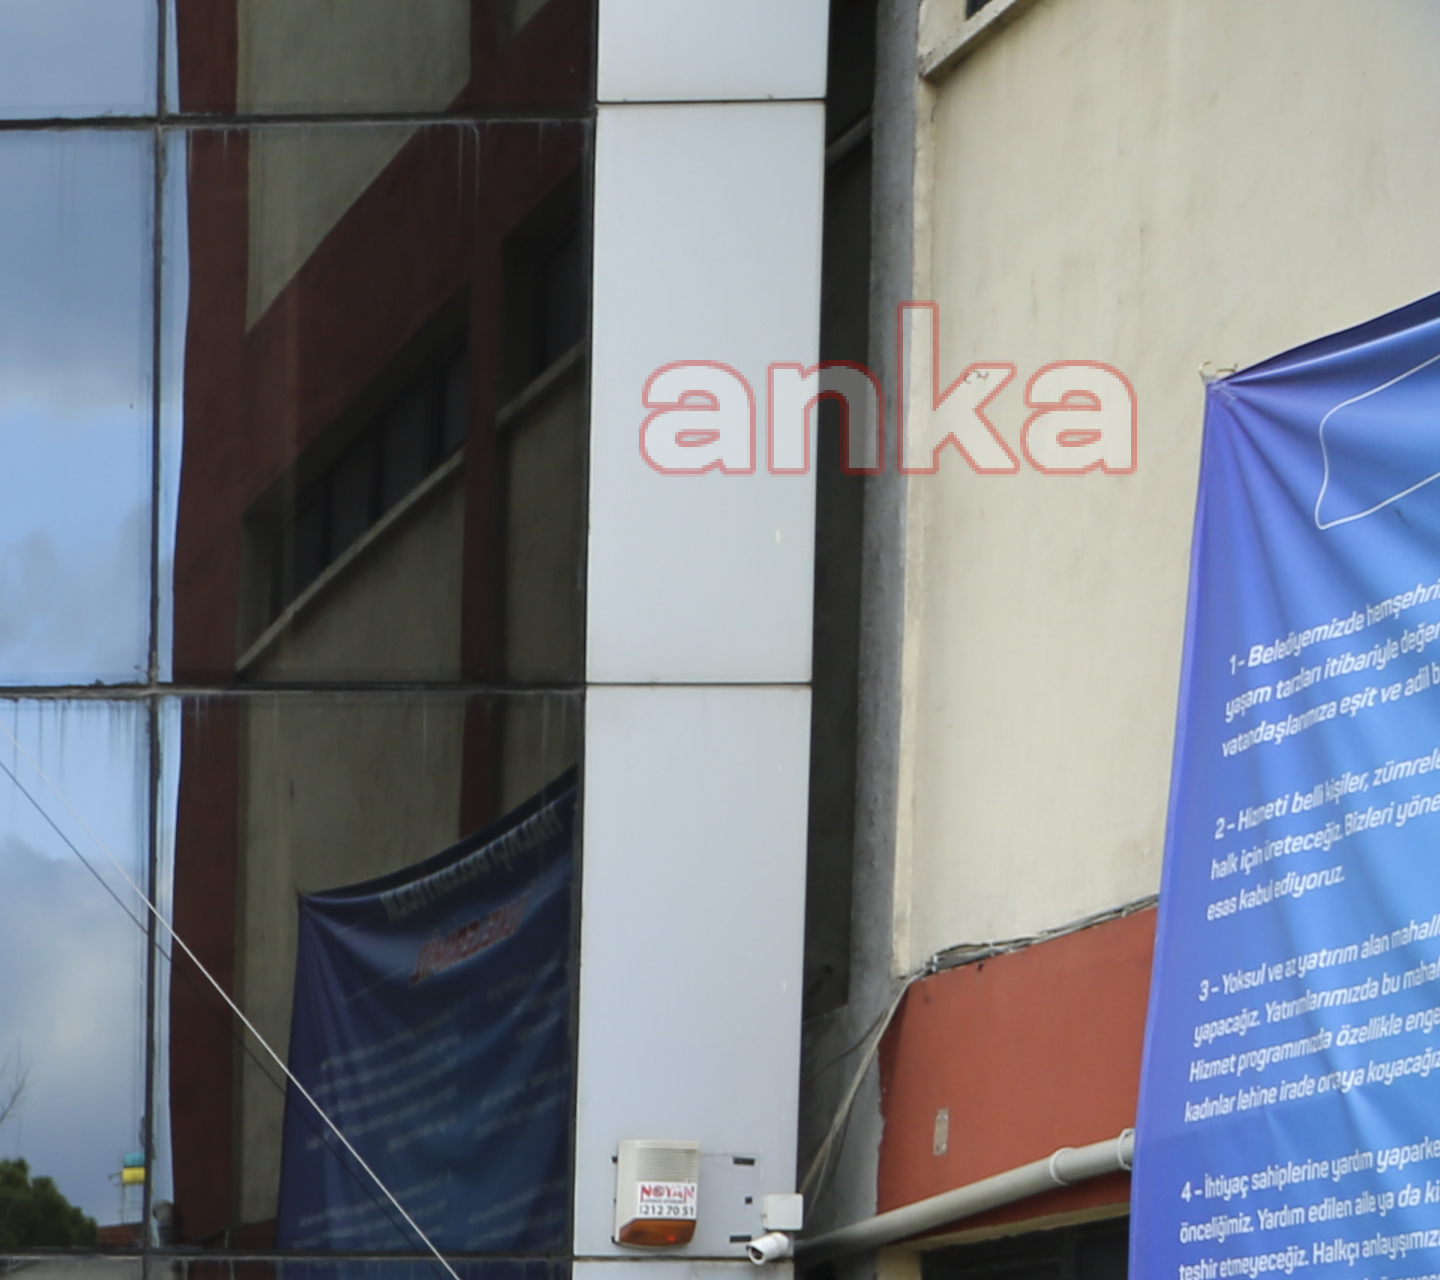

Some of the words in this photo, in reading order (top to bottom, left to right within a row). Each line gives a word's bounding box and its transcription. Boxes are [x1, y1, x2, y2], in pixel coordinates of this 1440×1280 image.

[1247, 611, 1365, 668] Belediyemizde
[1222, 700, 1337, 758] vatandaşlarımıza
[1339, 687, 1379, 718] eşit
[1381, 682, 1402, 704] ve
[1404, 666, 1430, 697] adil
[1225, 686, 1272, 723] yaşam
[1276, 666, 1322, 699] tarzları
[1323, 638, 1400, 681] itibariyle
[1214, 816, 1226, 840] 2
[1238, 793, 1289, 833] Hizmeti
[1291, 785, 1323, 814] belli
[1325, 772, 1369, 805] kişiler,
[1210, 852, 1239, 881] halk
[1240, 846, 1263, 876] için
[1345, 801, 1395, 837] Bizleri
[1207, 896, 1237, 922] esas
[1238, 879, 1274, 911] kabul
[1274, 865, 1345, 899] ediyoruz.
[1198, 978, 1210, 1002] 3
[1222, 963, 1268, 996] Yoksul
[1268, 962, 1284, 982] ve
[1297, 944, 1359, 979] yatırım
[1360, 933, 1391, 959] alan
[1391, 914, 1440, 950] mahall
[1193, 1007, 1262, 1049] yapacağız.
[1265, 976, 1380, 1023] Yatırımlarımızda
[1381, 972, 1401, 997] bu
[1189, 1050, 1237, 1083] Hizmet
[1237, 1028, 1333, 1077] programımızda
[1335, 1012, 1403, 1048] özellikle
[1184, 1093, 1237, 1123] kadınlar
[1237, 1084, 1278, 1113] lehine
[1279, 1075, 1315, 1102] irade
[1317, 1066, 1364, 1094] oraya
[1180, 1181, 1192, 1203] 4
[1204, 1172, 1249, 1202] İhtiyaç
[1251, 1159, 1330, 1192] sahiplerine
[1331, 1148, 1373, 1183] yardım
[1179, 1212, 1255, 1244] önceliğimiz.
[1255, 1203, 1306, 1230] Yardım
[1307, 1197, 1353, 1223] edilen
[1354, 1190, 1377, 1216] aile
[1377, 1191, 1395, 1217] ya
[1397, 1183, 1421, 1208] da
[1219, 1244, 1310, 1280] etmeyeceğiz.
[1312, 1238, 1361, 1267] Halkçı
